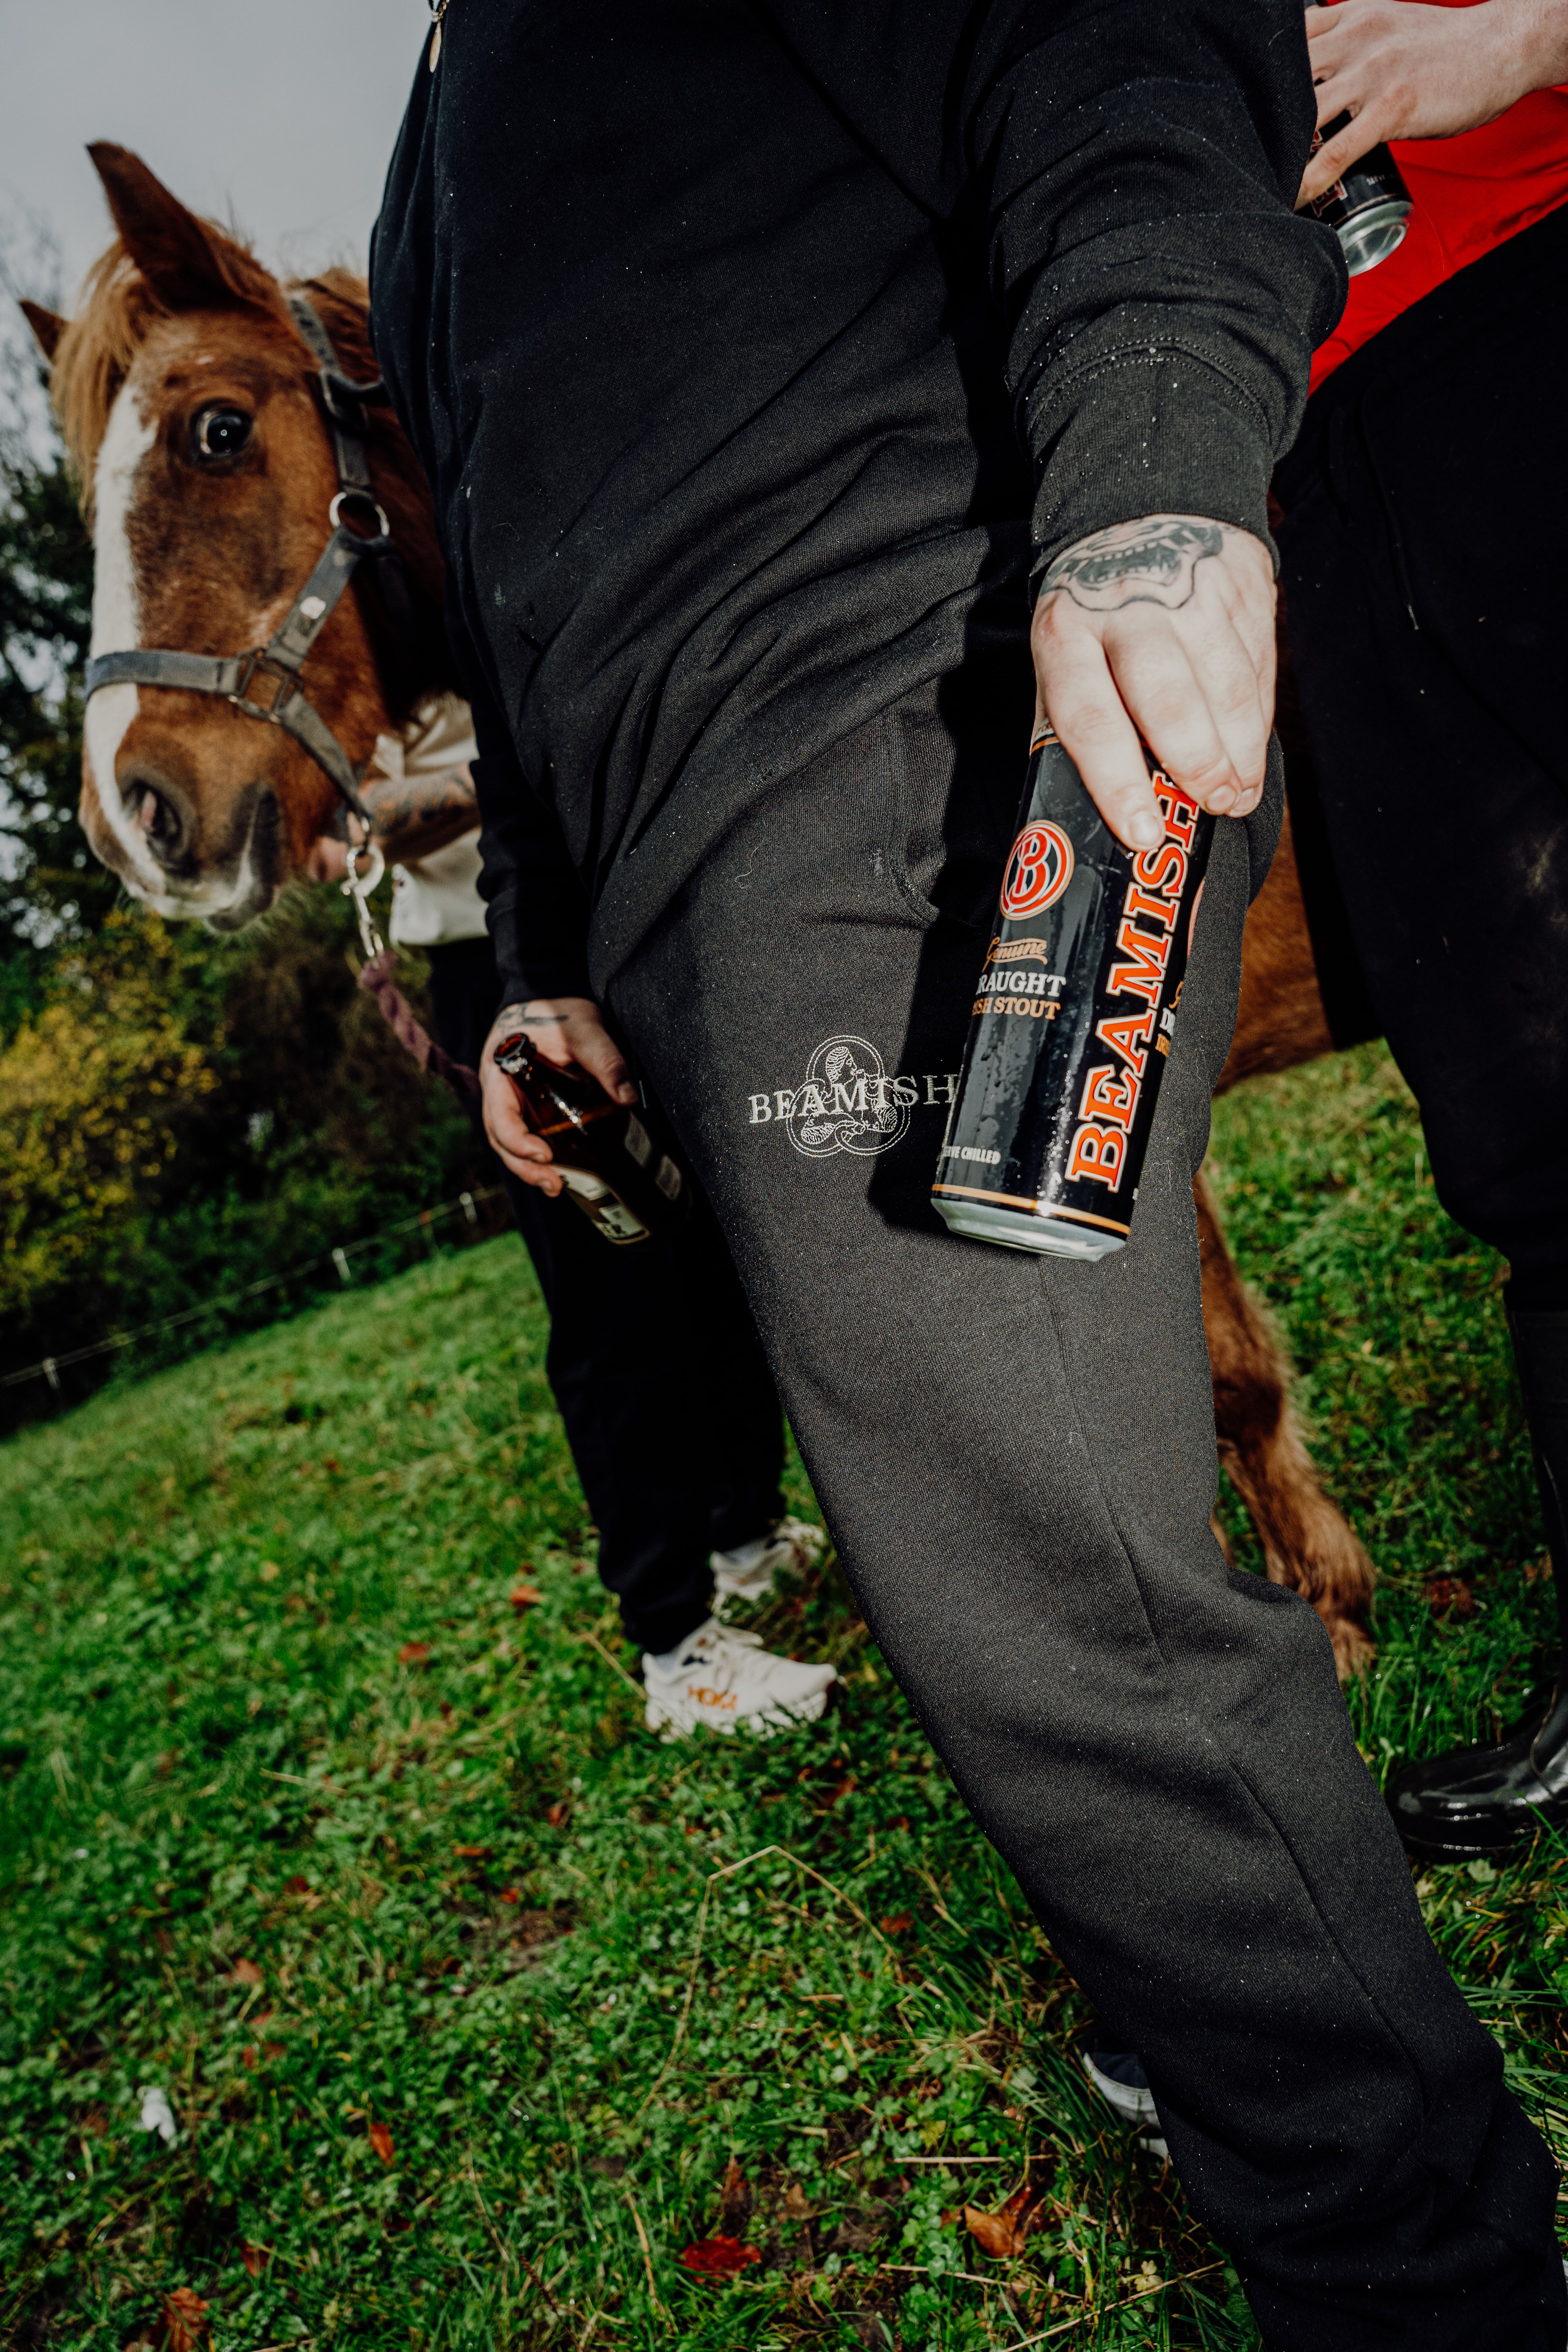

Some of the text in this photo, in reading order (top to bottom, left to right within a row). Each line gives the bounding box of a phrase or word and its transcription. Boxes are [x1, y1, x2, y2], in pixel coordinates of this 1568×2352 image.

[1001, 822, 1071, 917] B
[976, 971, 1066, 997] RAUGHT
[1065, 770, 1199, 1193] BEAMISH
[993, 997, 1061, 1020] STOUT
[748, 1074, 958, 1124] BEAMISH
[961, 1146, 1001, 1165] CHILLED
